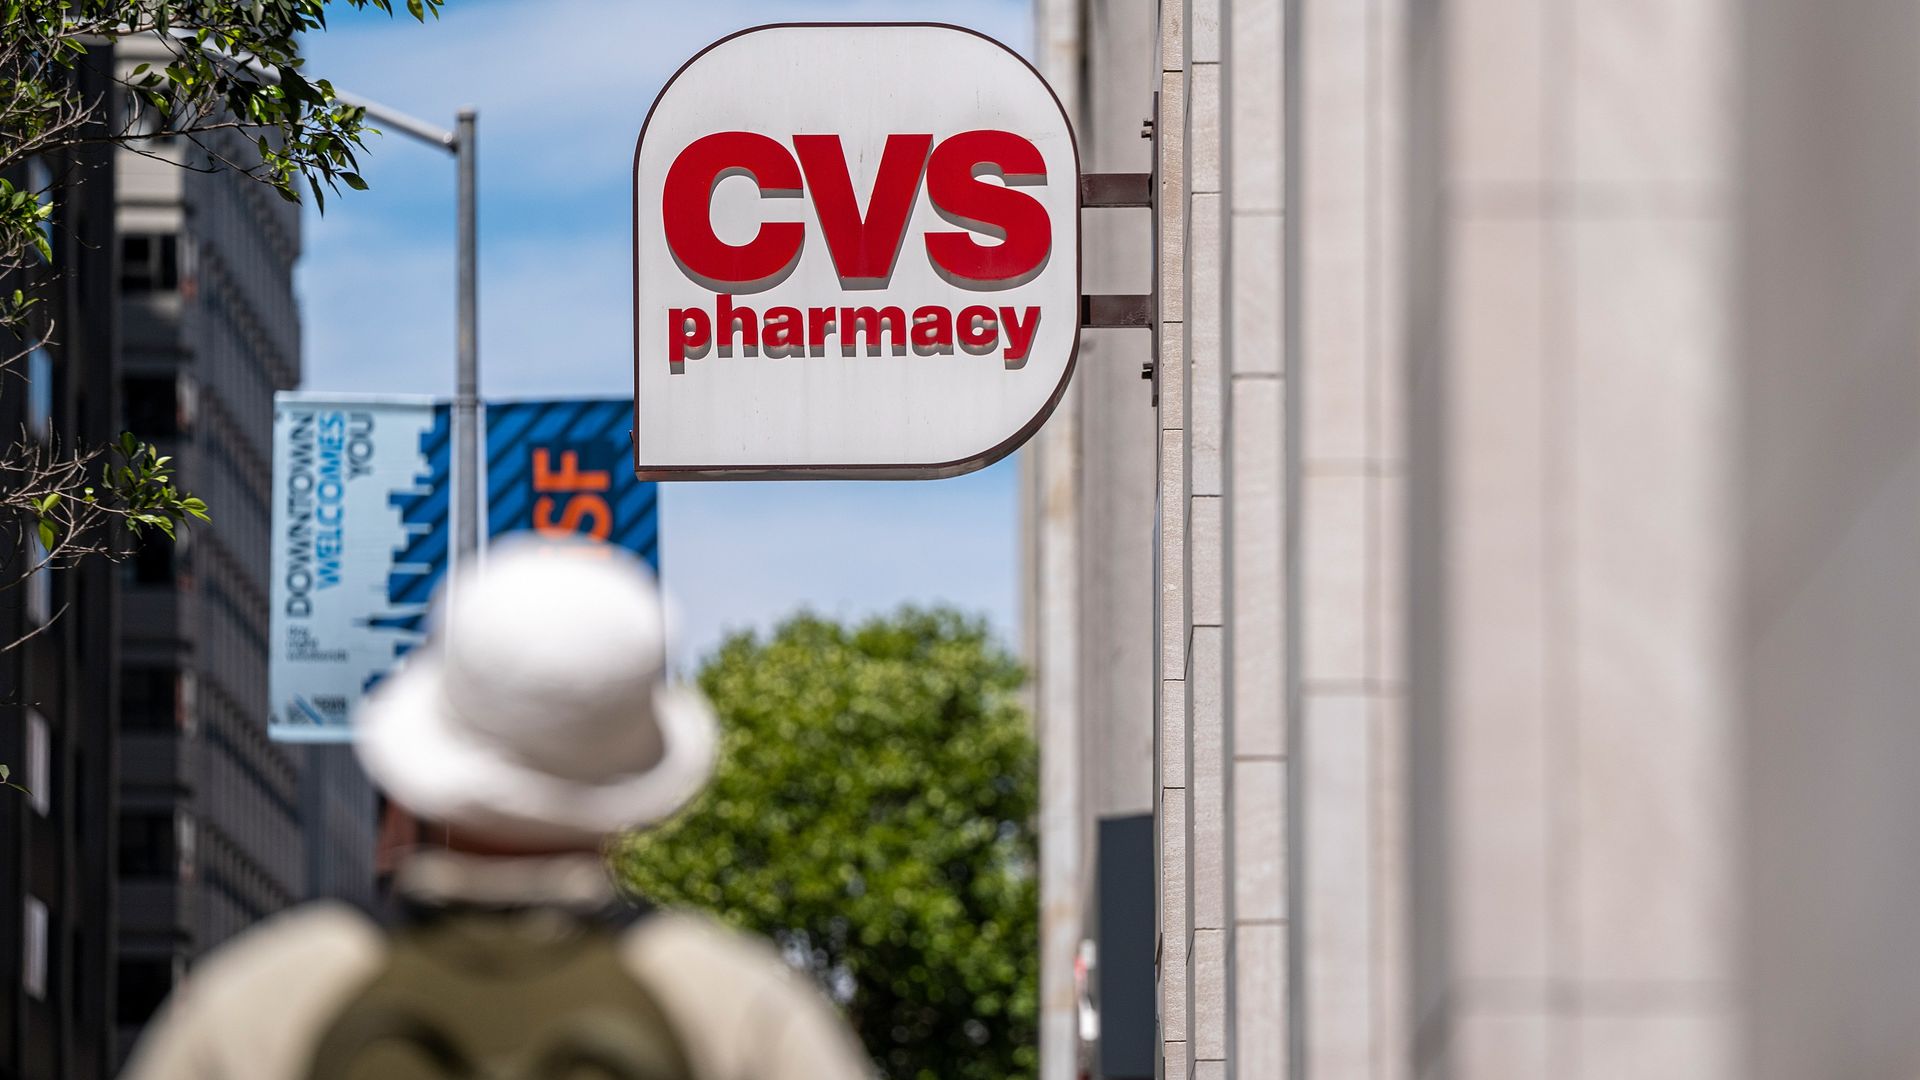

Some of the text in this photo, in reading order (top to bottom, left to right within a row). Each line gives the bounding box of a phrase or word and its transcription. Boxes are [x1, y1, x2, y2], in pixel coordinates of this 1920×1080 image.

[662, 130, 1052, 288] CVS
[668, 294, 1041, 369] pharmacy
[315, 410, 346, 590] WELCOMES
[347, 411, 375, 482] YOU
[532, 447, 613, 555] SF
[286, 411, 315, 618] DOWNTOWN
